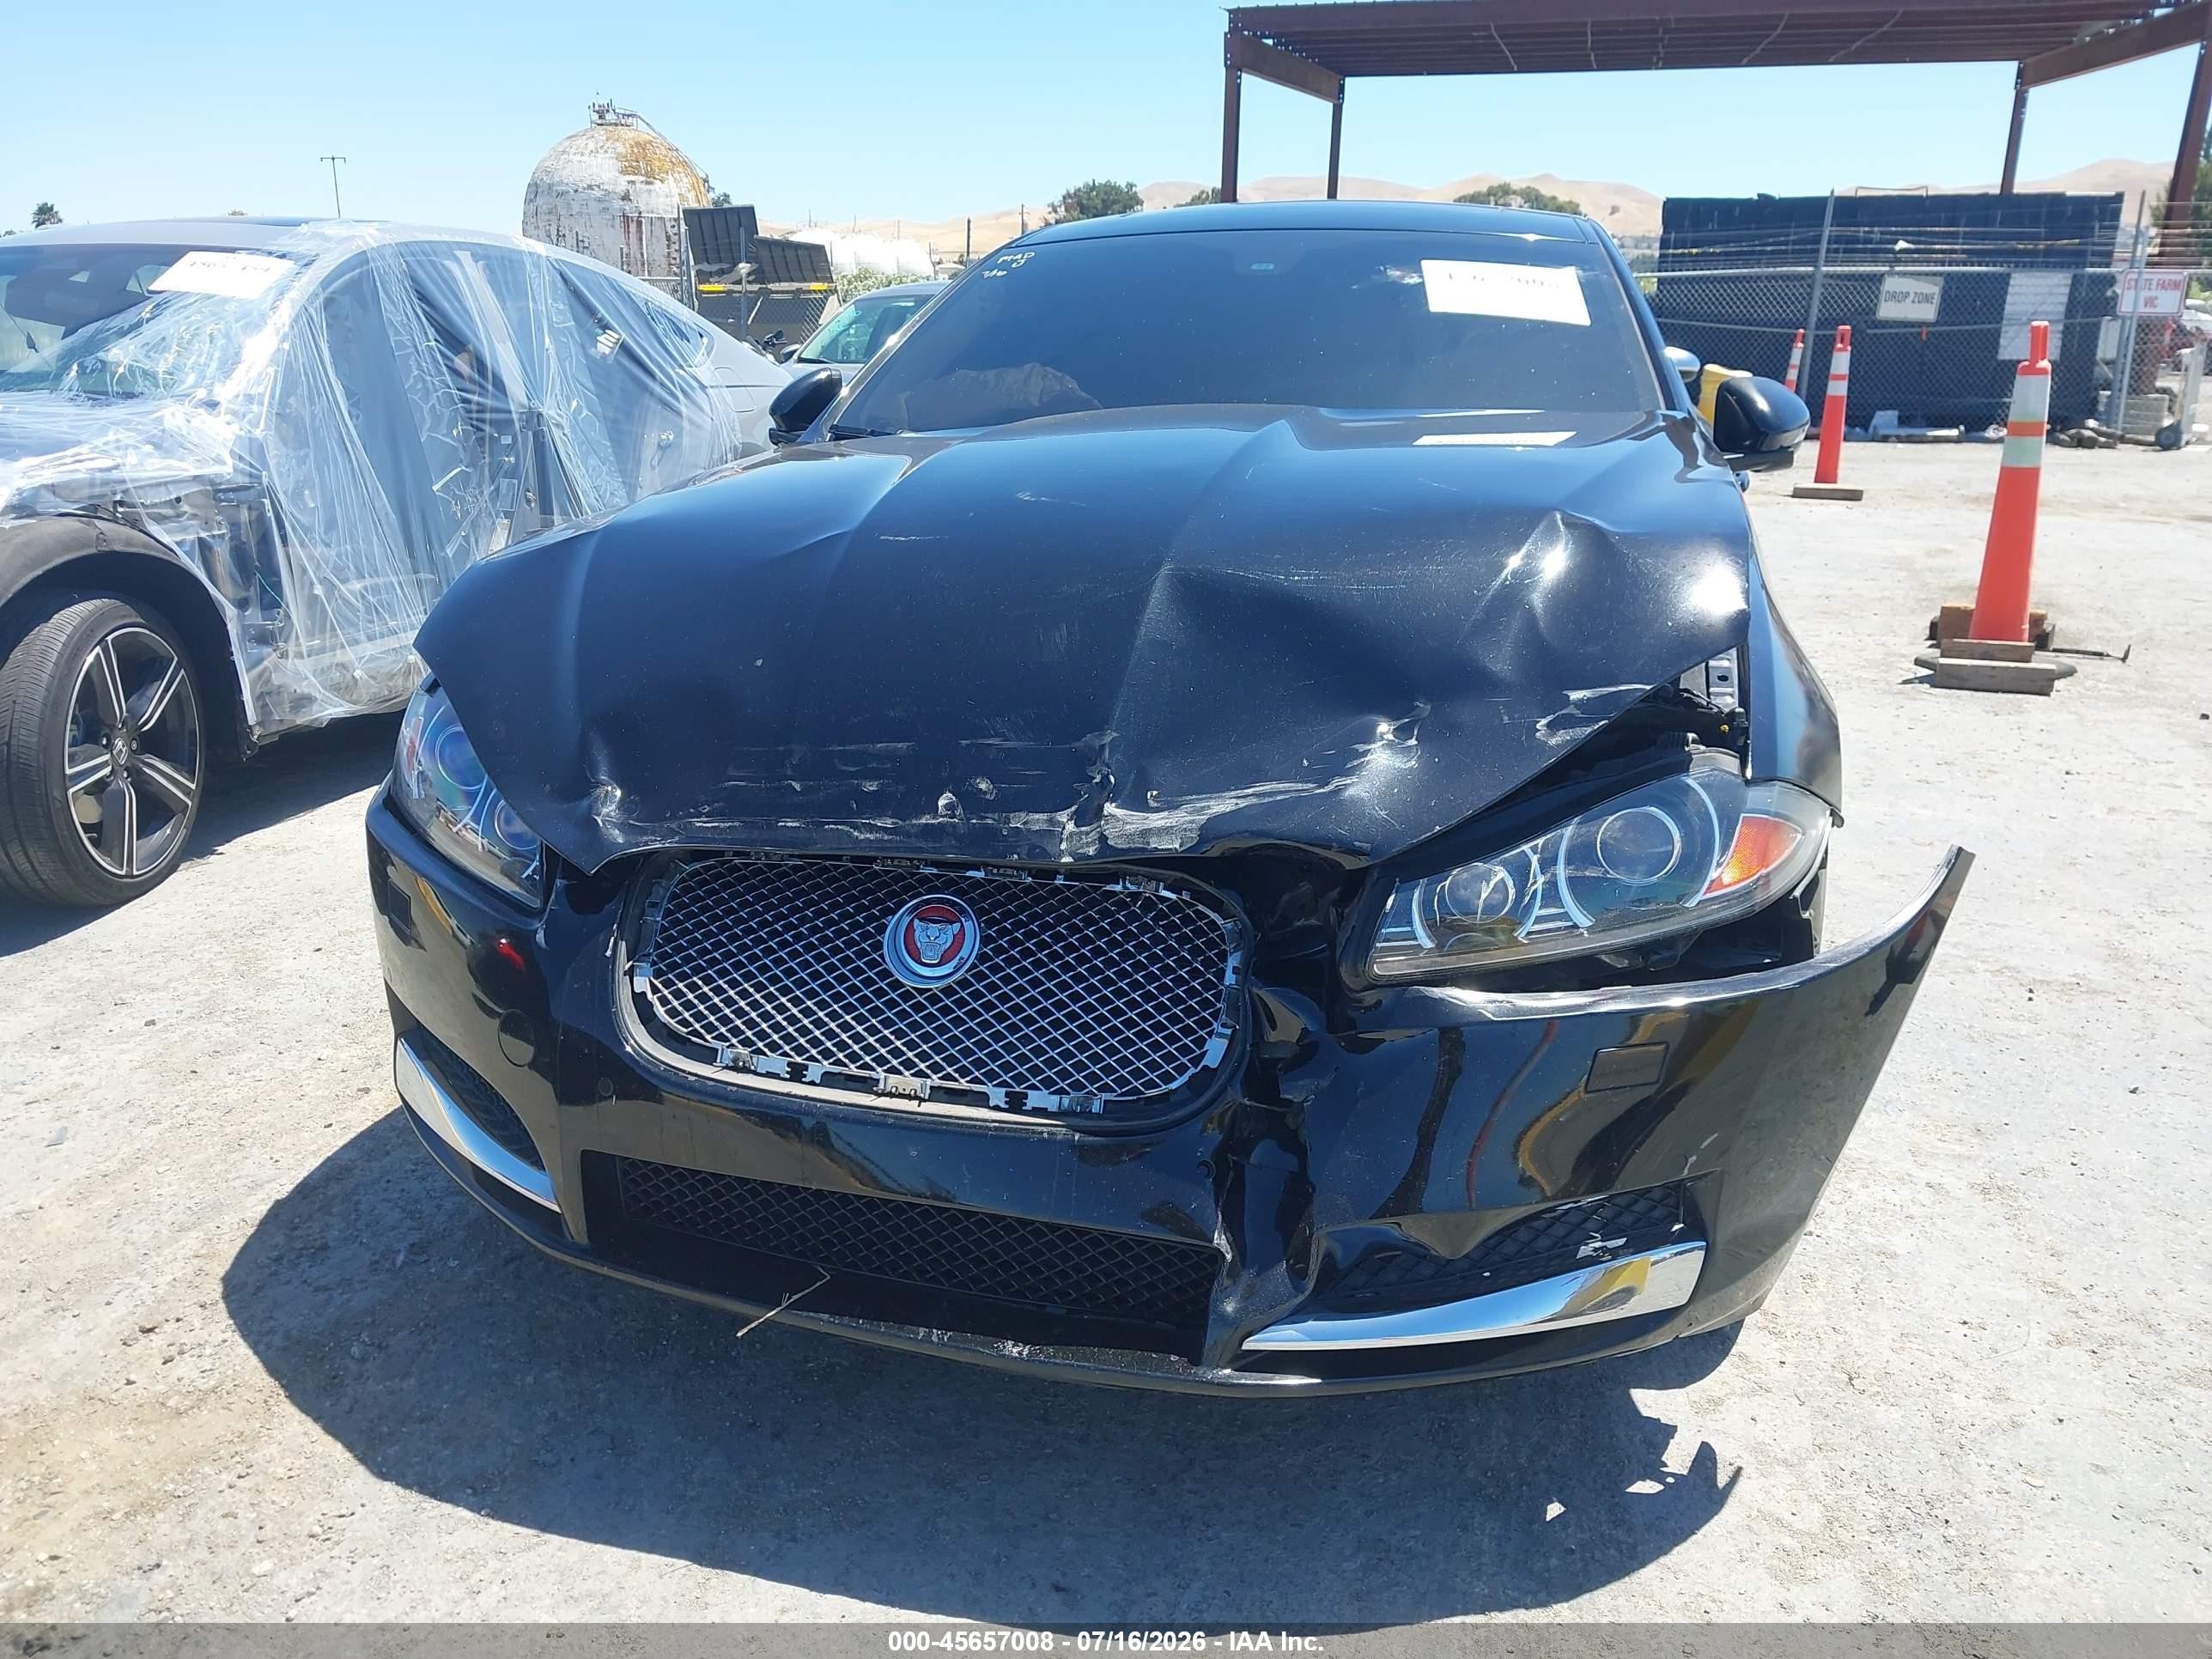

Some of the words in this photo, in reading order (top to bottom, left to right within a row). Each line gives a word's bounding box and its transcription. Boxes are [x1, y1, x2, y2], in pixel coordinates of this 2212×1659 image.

[2126, 277, 2154, 290] STTE
[2156, 278, 2184, 290] FARM
[1884, 289, 1911, 303] DROP
[1911, 291, 1936, 304] ZONE
[2143, 295, 2158, 308] VIC
